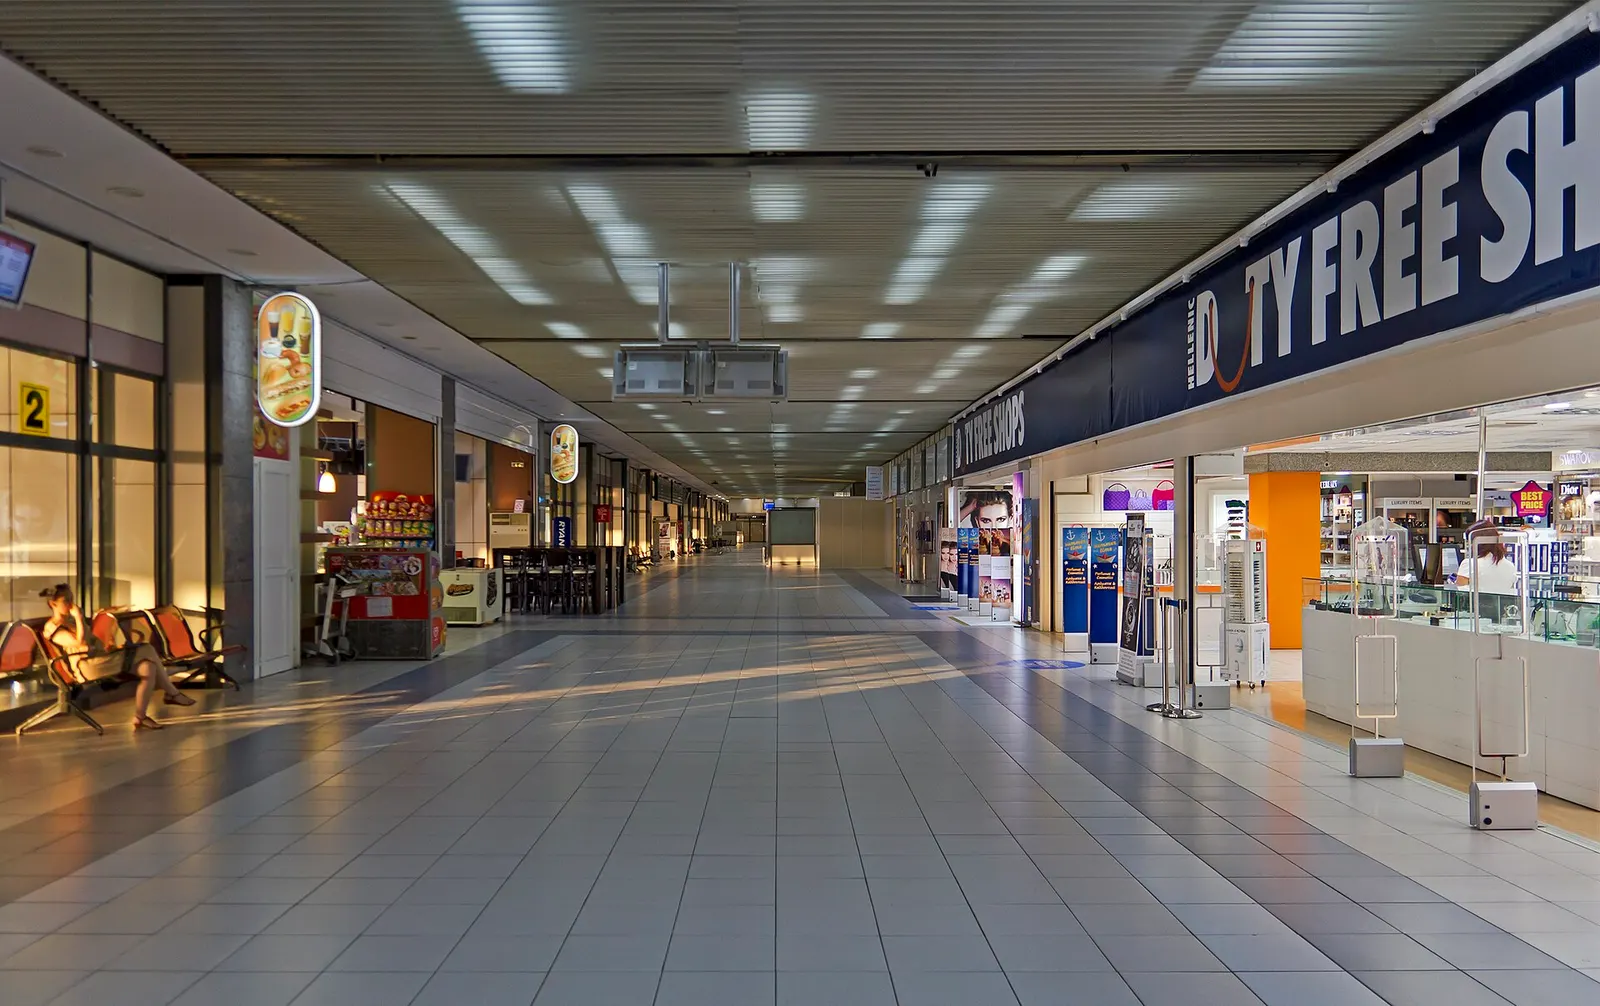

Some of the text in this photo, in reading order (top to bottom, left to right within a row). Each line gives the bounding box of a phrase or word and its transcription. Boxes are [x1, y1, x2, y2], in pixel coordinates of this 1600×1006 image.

[1312, 146, 1459, 345] FREE
[1187, 297, 1195, 390] HELLENIC
[26, 390, 43, 428] 2
[974, 409, 993, 461] FREE
[993, 390, 1025, 455] SHOPS
[1521, 492, 1543, 500] BEST
[1521, 501, 1544, 509] PRICE
[1561, 484, 1579, 495] Dior
